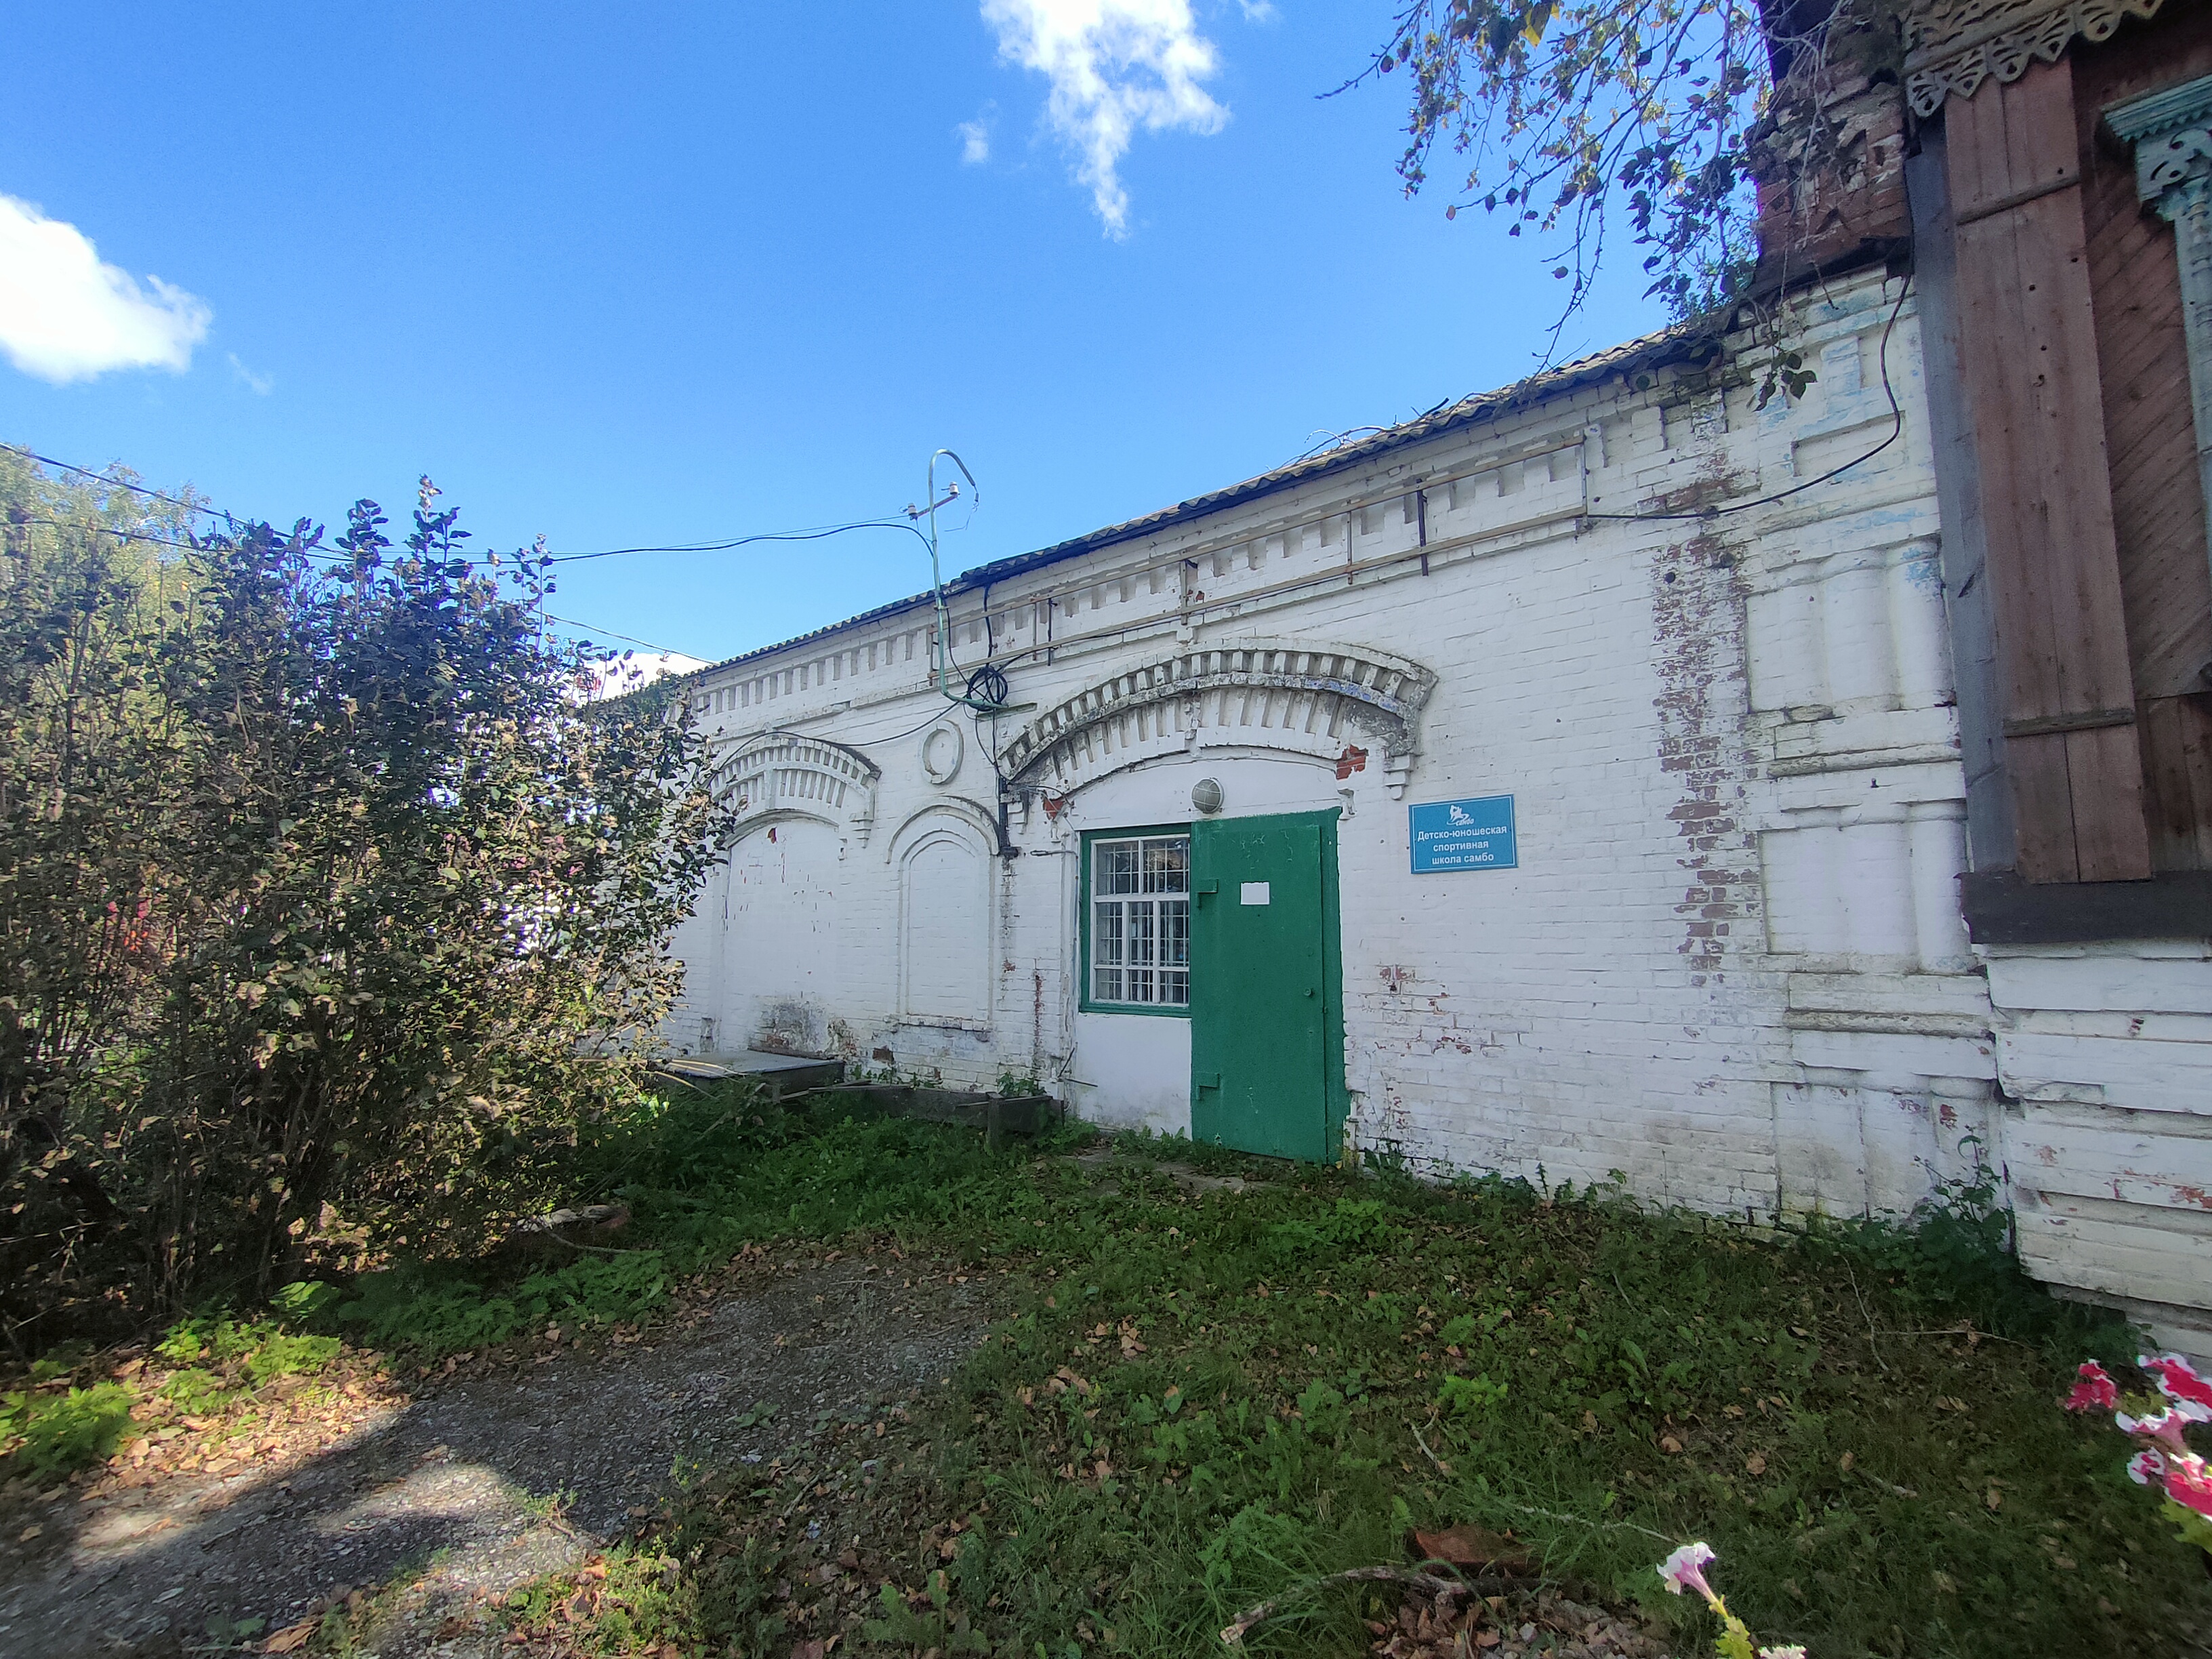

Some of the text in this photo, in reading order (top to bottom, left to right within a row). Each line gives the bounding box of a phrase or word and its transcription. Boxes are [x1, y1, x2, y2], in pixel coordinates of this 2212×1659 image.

[1417, 826, 1507, 842] Детско-юношеская
[1433, 841, 1489, 853] спортивная
[1432, 853, 1494, 865] школа самбо
